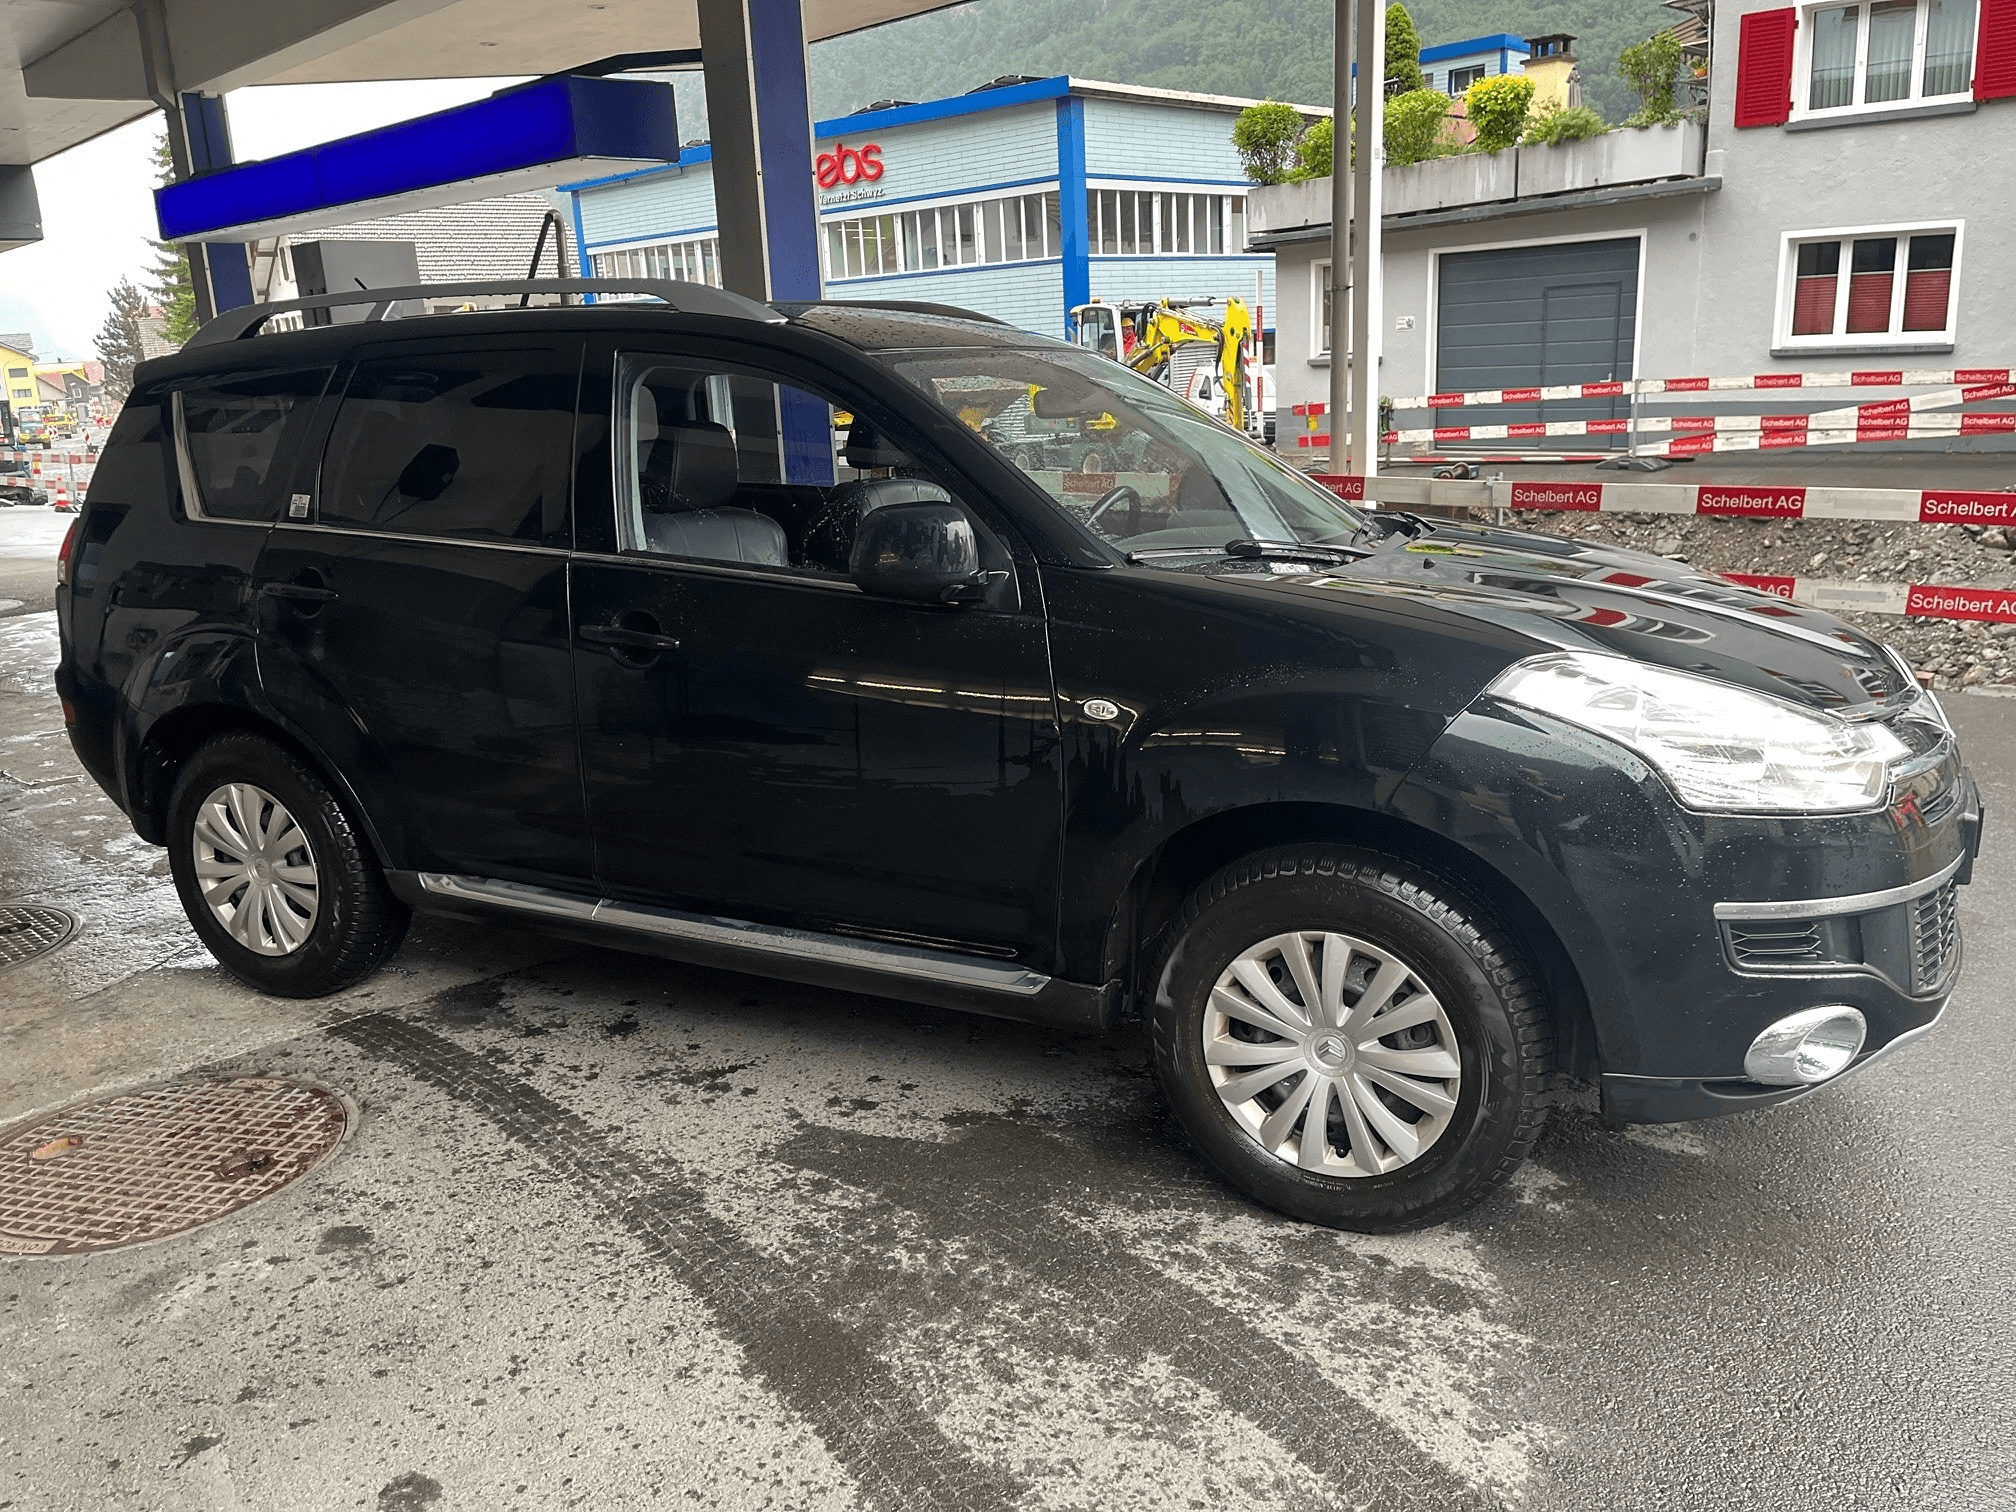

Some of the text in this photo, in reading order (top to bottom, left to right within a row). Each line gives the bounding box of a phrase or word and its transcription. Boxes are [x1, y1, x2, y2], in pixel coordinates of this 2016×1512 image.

[816, 143, 884, 189] ebs
[1852, 374, 1901, 384] Schelbert AG
[1502, 390, 1540, 401] Schelbert AG
[1582, 385, 1621, 396] Schelbert AG
[1964, 385, 2015, 399] Schelbert AG
[1428, 395, 1464, 405] Schelbert AG
[1859, 402, 1908, 417] Schelbert AG
[1587, 421, 1627, 432] Schelbert AG
[1672, 420, 1702, 428] Schelbert
[1762, 418, 1807, 427] Schelbert AG
[1859, 417, 1908, 426] Schelbert AG
[1963, 417, 2015, 425] Schelbert AG
[1433, 429, 1469, 439] Schelbert AG
[1508, 425, 1545, 436] Schelbert AG
[1760, 435, 1806, 446] Schelbert AG
[1670, 441, 1712, 452] Schelbert AG
[1344, 482, 1362, 494] AG
[1513, 489, 1597, 504] Schelbert AG
[1701, 493, 1802, 510] Schelbert AG
[1924, 499, 2008, 517] Schelbert
[1910, 593, 1993, 614] Schelbert
